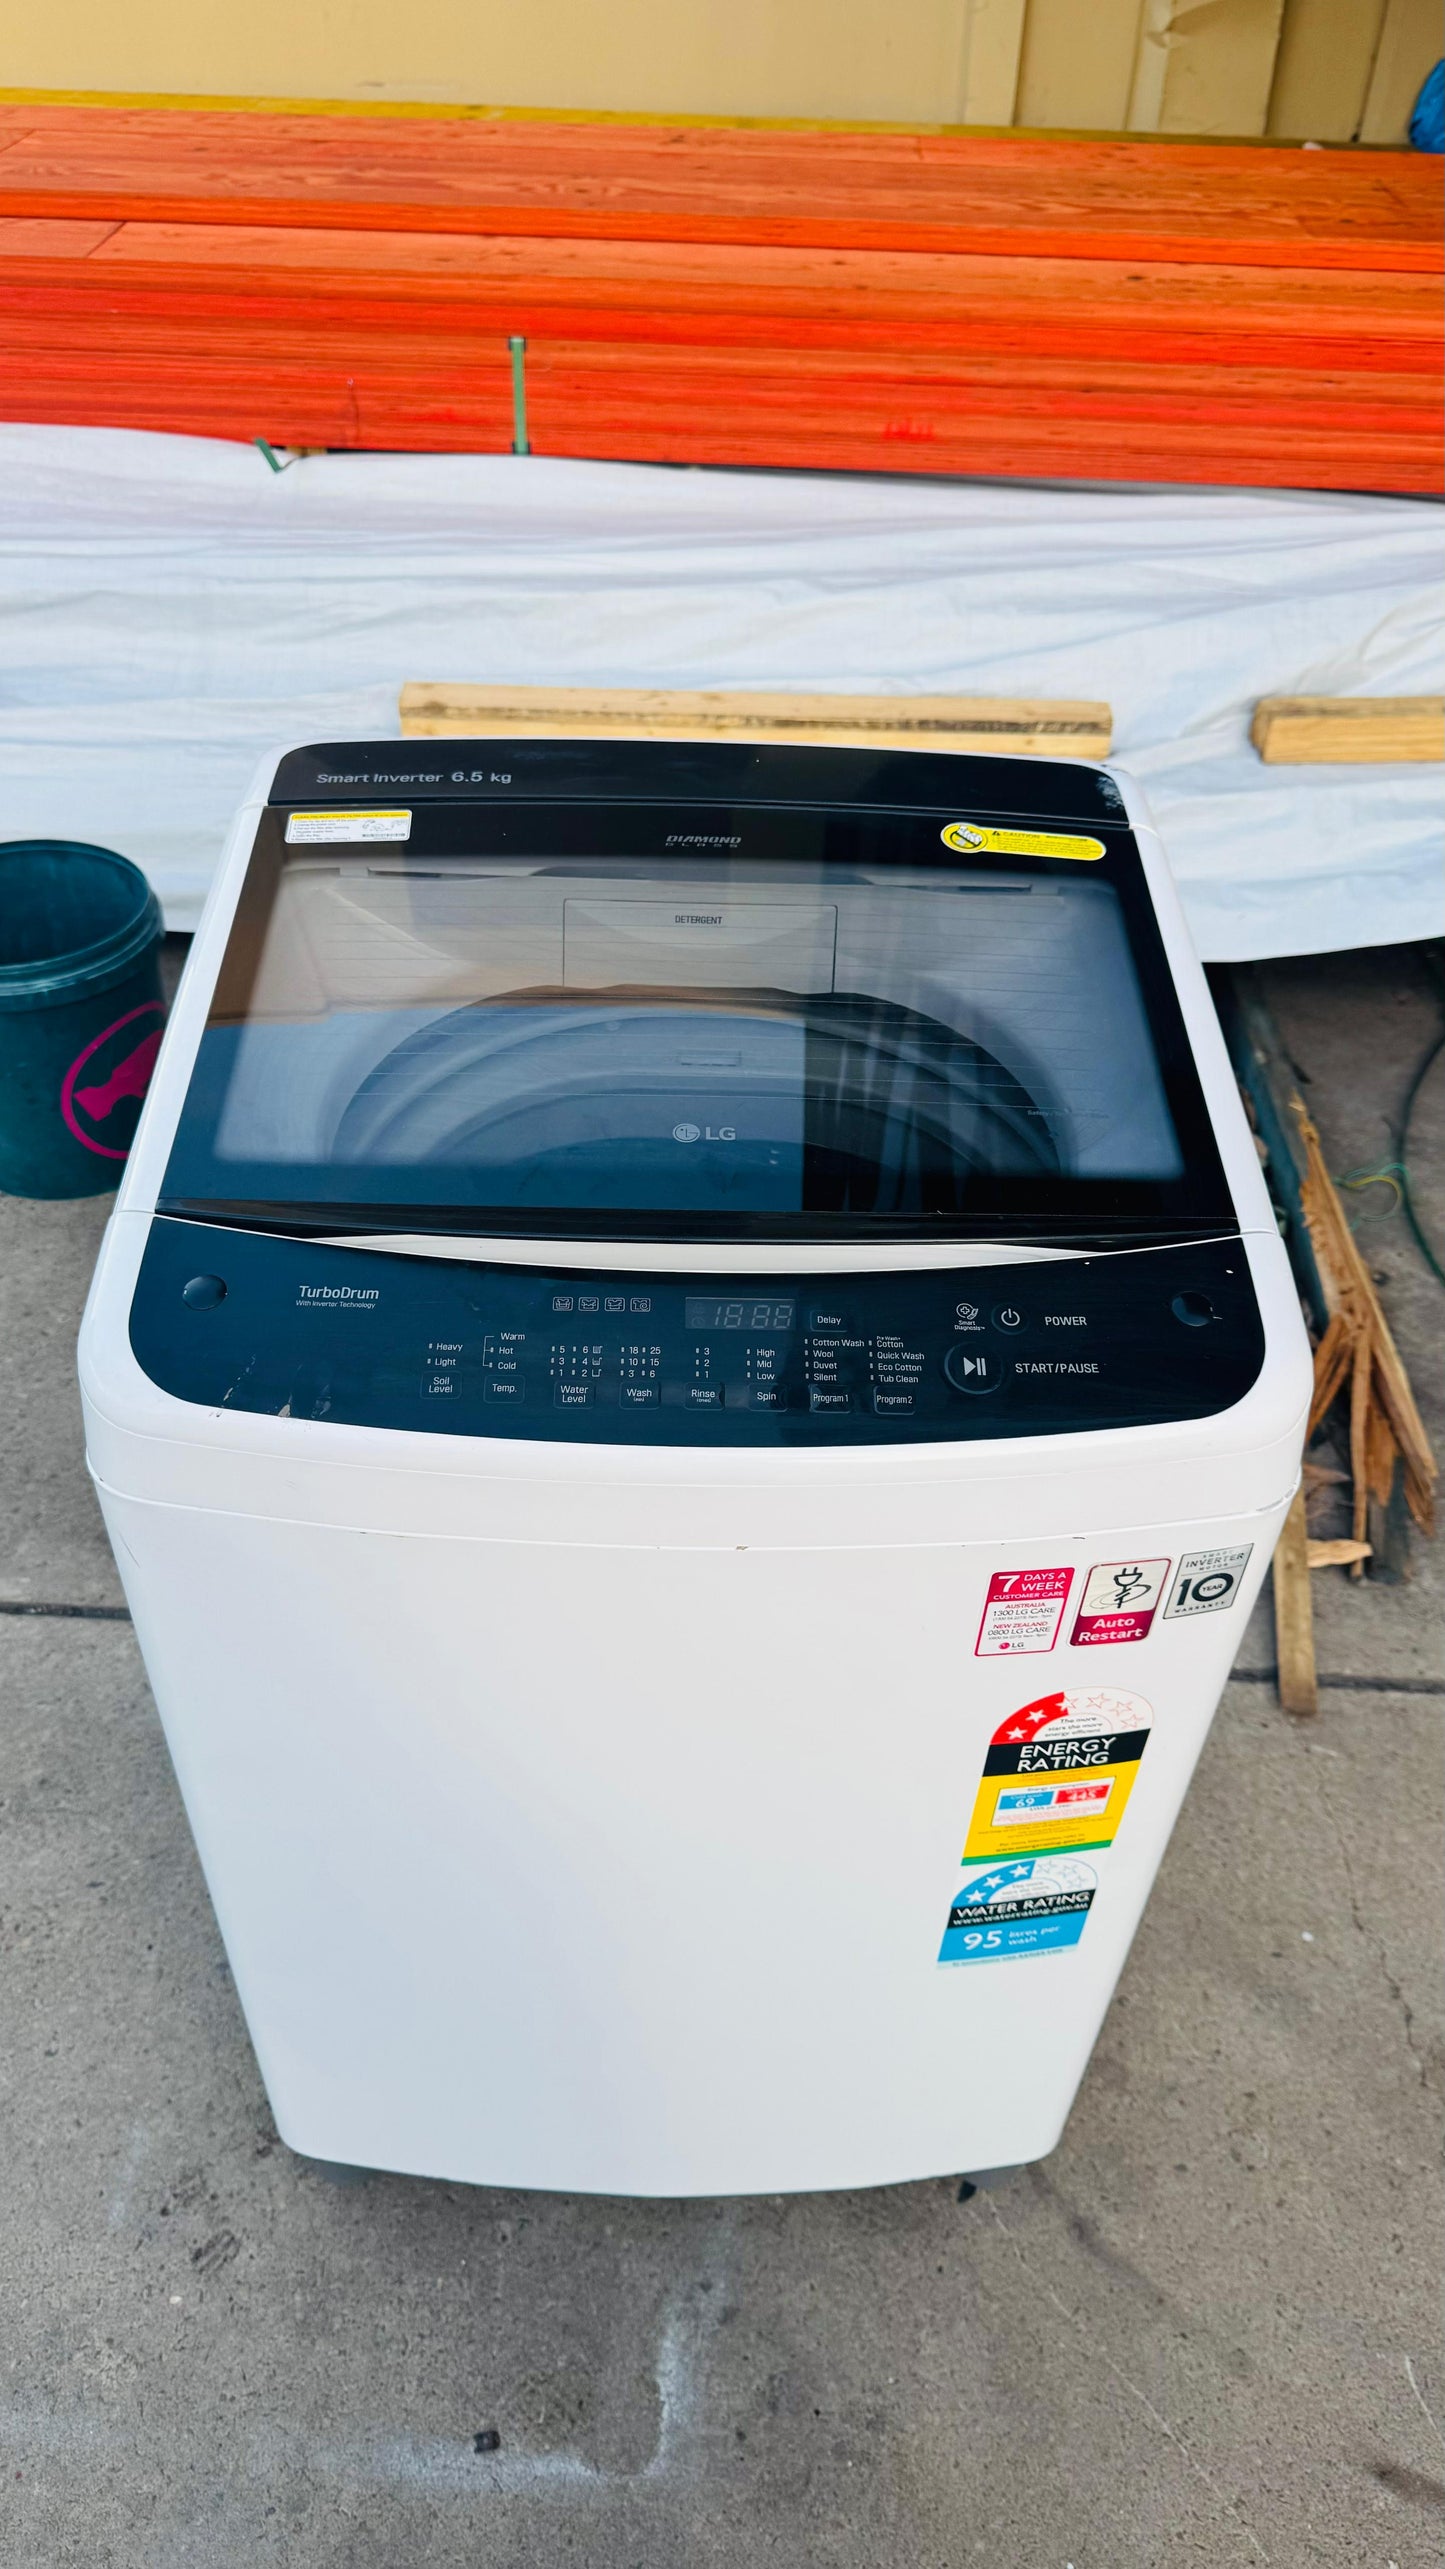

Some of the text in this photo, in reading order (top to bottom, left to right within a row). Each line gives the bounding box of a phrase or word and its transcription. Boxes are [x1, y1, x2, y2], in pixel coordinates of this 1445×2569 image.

[316, 771, 512, 784] Smart Inverter 6.5 kg
[666, 835, 742, 844] DIAMOND
[675, 914, 723, 925] DETERGENT
[705, 1126, 736, 1141] LG
[299, 1285, 380, 1300] TurboDrum
[295, 1299, 376, 1309] With Inverter Technology
[817, 1315, 841, 1325] Delay
[1045, 1316, 1088, 1326] POWER
[500, 1332, 526, 1341] Warm
[812, 1338, 865, 1347] Cotton Wash
[876, 1340, 904, 1349] Cotton
[436, 1343, 463, 1352] Heavy
[498, 1346, 514, 1355] Hot
[559, 1345, 589, 1354] 5 6
[629, 1346, 661, 1355] 18 25
[704, 1347, 710, 1355] 3
[756, 1348, 775, 1357] High
[813, 1350, 834, 1358] Wool
[877, 1351, 925, 1360] Quick Wash
[435, 1357, 457, 1367] Light
[497, 1361, 517, 1370] Cold
[558, 1357, 588, 1365] 3 4
[628, 1358, 660, 1366] 10 15
[704, 1359, 710, 1367] 2
[756, 1360, 772, 1368] Mid
[813, 1361, 838, 1370] Duvet
[878, 1363, 922, 1372] Eco Cotton
[1015, 1363, 1100, 1374] START/PAUSE
[581, 1369, 588, 1377] 2
[628, 1370, 656, 1378] 3 6
[756, 1372, 775, 1380] Low
[813, 1373, 837, 1382] Silent
[433, 1376, 450, 1386] Soil
[878, 1374, 919, 1383] Tub Clean
[428, 1384, 453, 1393] Level
[492, 1383, 518, 1395] Temp.
[560, 1385, 588, 1394] Water
[626, 1388, 652, 1397] Wash
[691, 1389, 716, 1398] Rinse
[756, 1391, 777, 1402] Spin
[813, 1393, 844, 1403] Program
[562, 1394, 586, 1403] Level
[1185, 1553, 1244, 1568] INVERTER
[998, 1574, 1021, 1593] 7
[1023, 1572, 1055, 1582] DAYS
[1021, 1581, 1065, 1591] WEEK
[1176, 1572, 1234, 1606] 10
[1202, 1583, 1223, 1592] YEAR
[993, 1592, 1041, 1601] CUSTOMER
[1174, 1601, 1226, 1613] WARRANTY
[1092, 1617, 1136, 1630] Auto
[1078, 1628, 1143, 1642] Restart
[1020, 1736, 1117, 1758] ENERGY
[1017, 1751, 1109, 1772] RATING
[1015, 1797, 1036, 1808] 69
[956, 1892, 1091, 1919] WATER RATING
[963, 1929, 1003, 1951] 95
